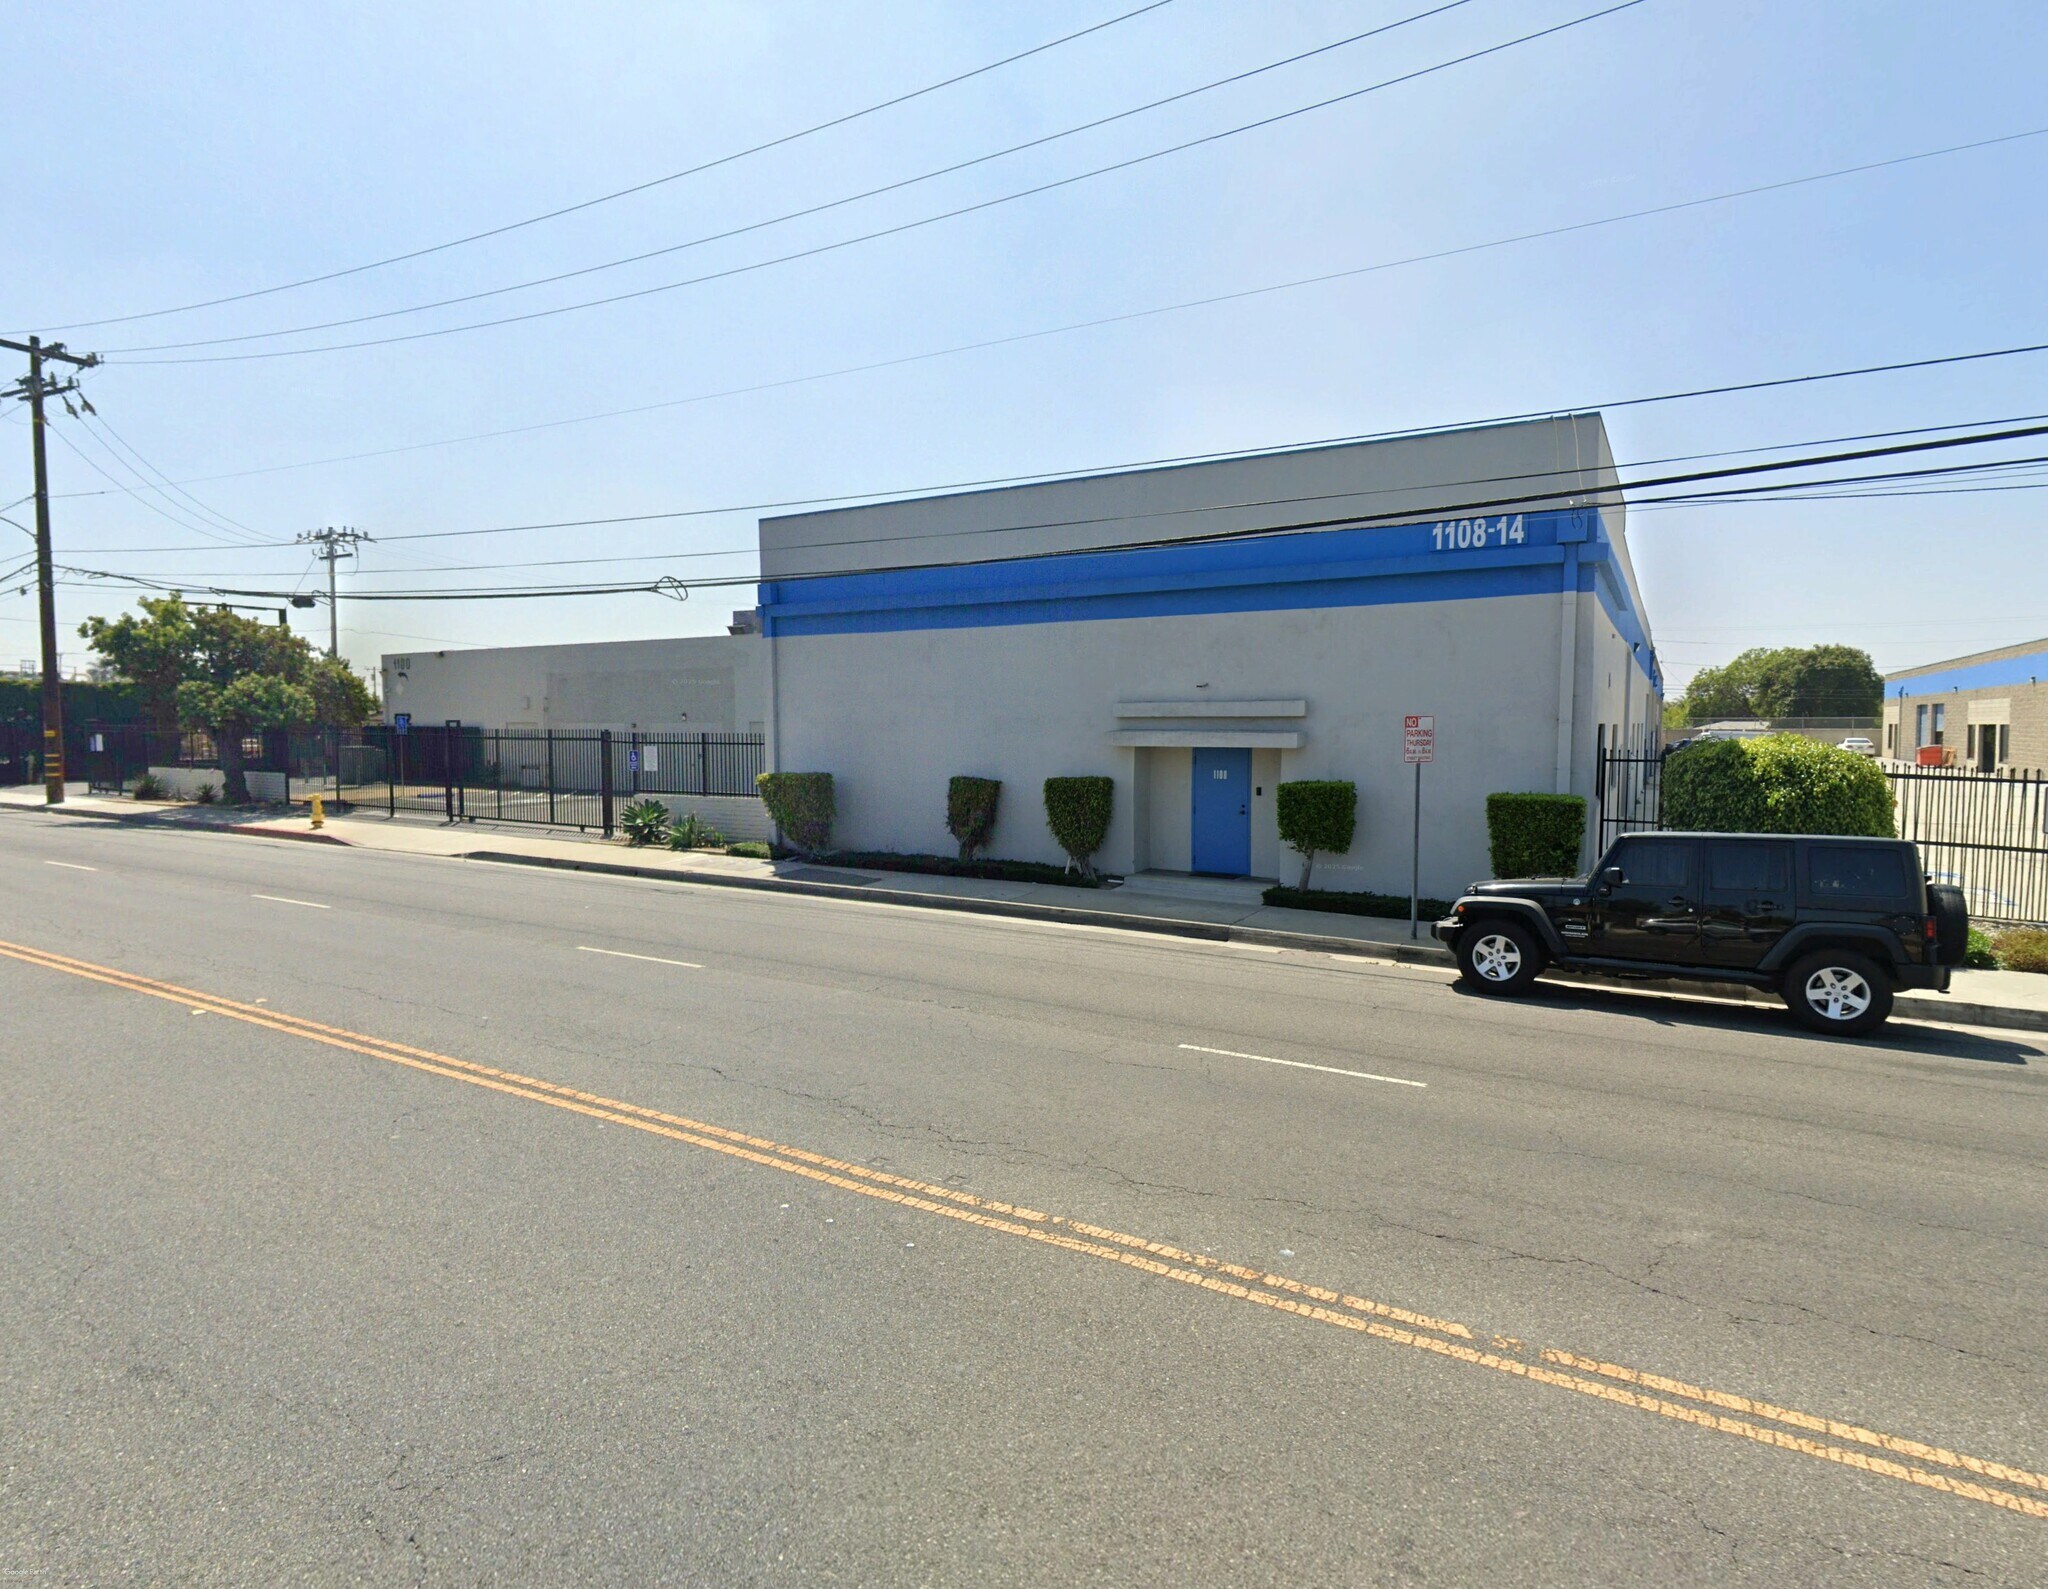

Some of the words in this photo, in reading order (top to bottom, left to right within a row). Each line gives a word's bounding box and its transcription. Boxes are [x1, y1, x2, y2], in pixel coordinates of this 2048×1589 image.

[1432, 514, 1524, 550] 1108-14
[1406, 717, 1418, 727] NO
[1406, 729, 1432, 738] PARKING
